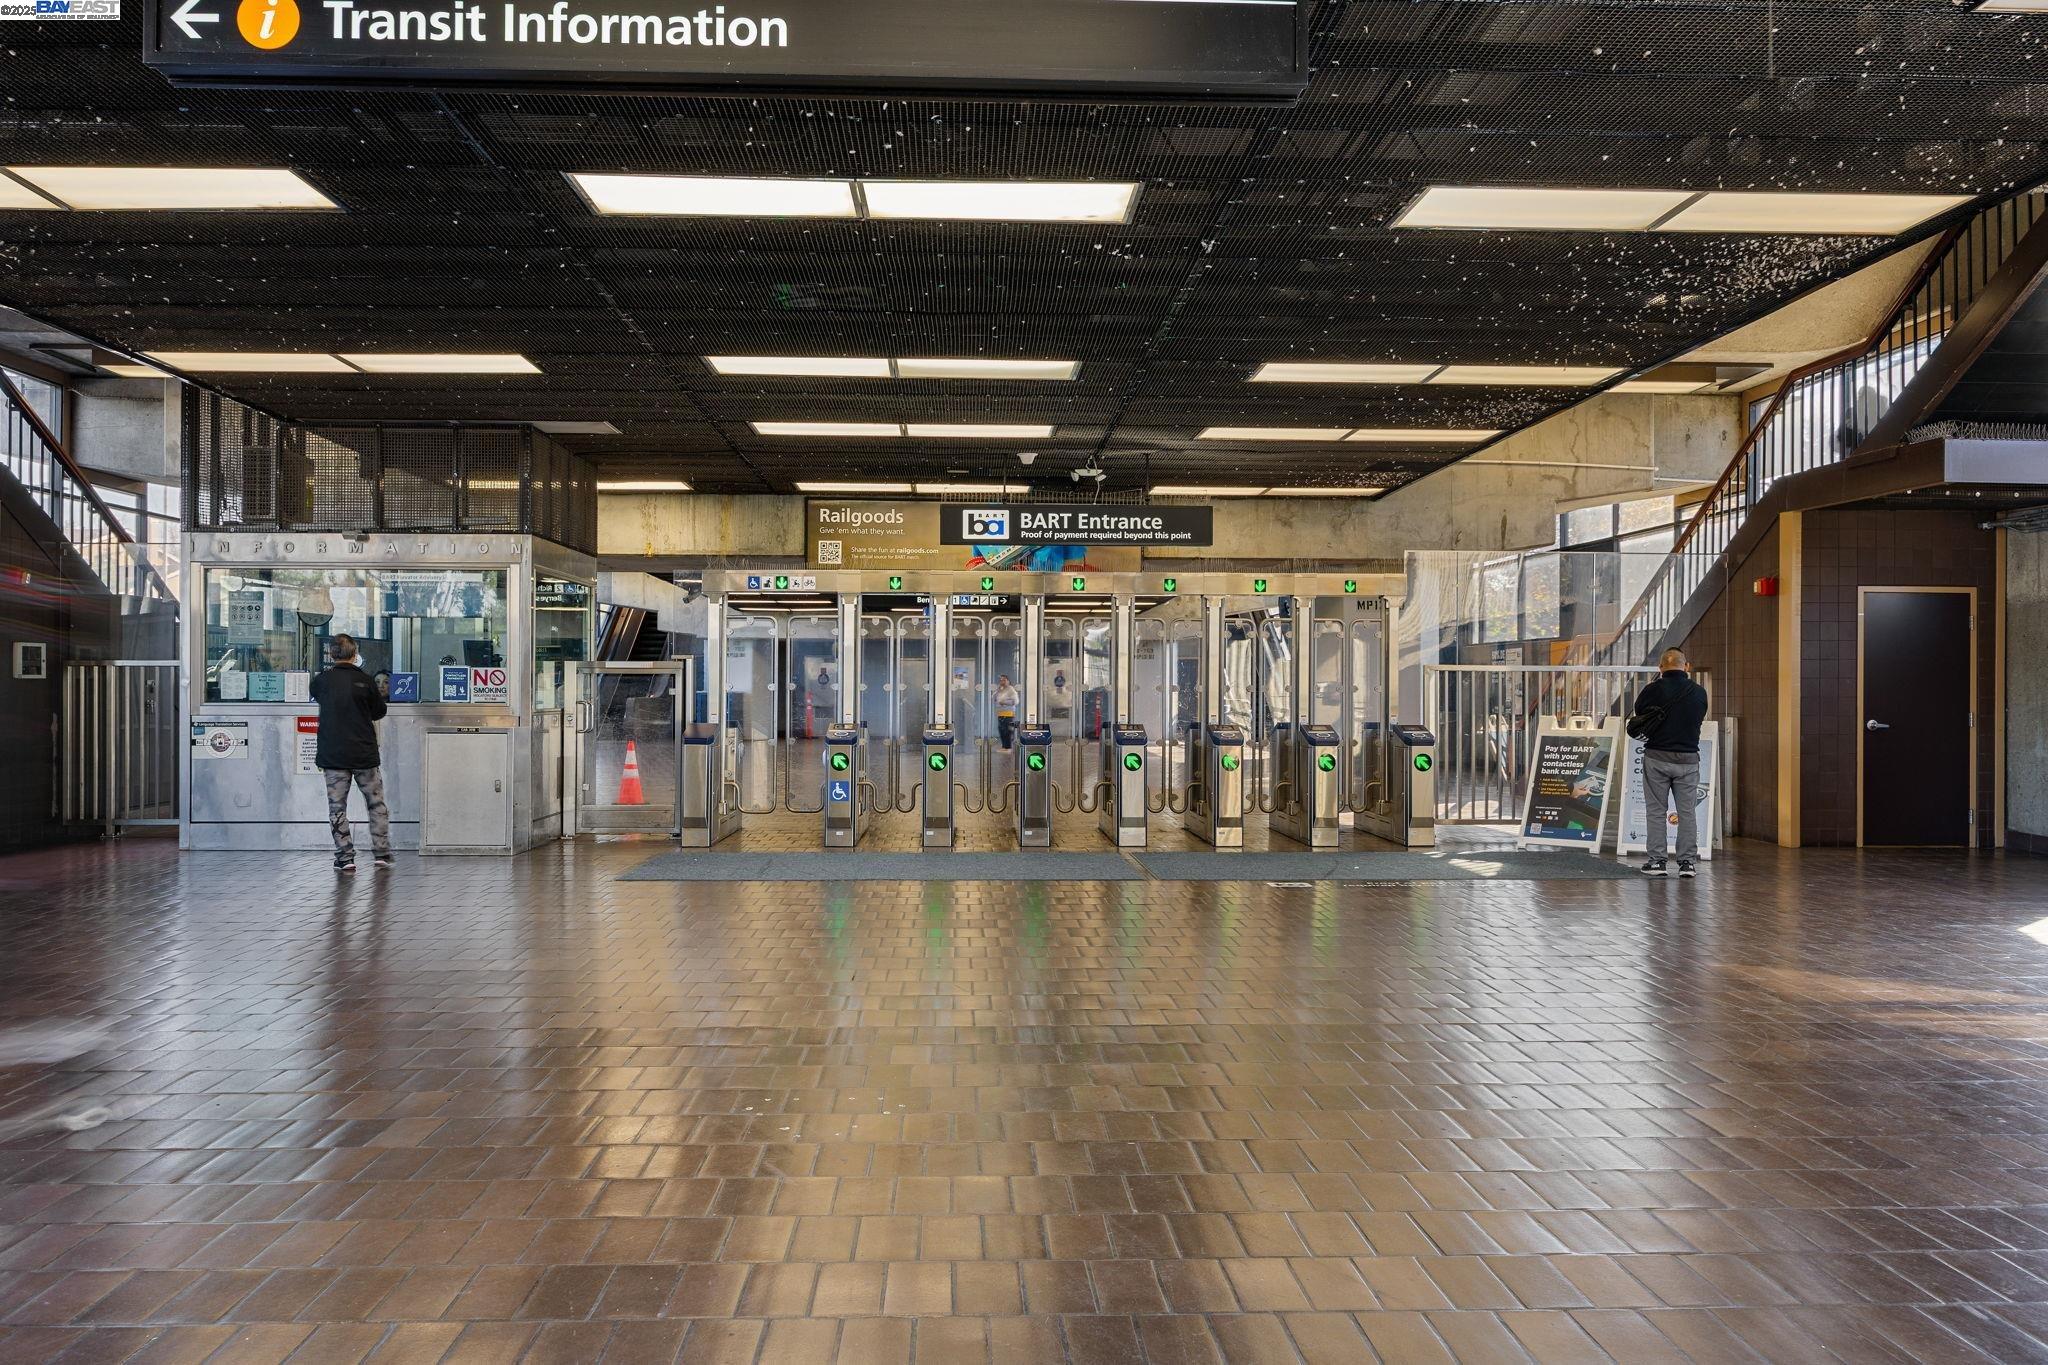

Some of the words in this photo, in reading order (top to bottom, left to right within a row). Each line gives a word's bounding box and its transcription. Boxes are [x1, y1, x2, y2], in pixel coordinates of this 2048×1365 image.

[322, 1, 487, 42] Transit
[504, 2, 788, 47] Information
[819, 508, 904, 526] Railgoods
[1020, 513, 1072, 529] BART
[1078, 513, 1163, 530] Entrance
[850, 527, 869, 535] what
[870, 528, 885, 536] they
[1021, 531, 1043, 539] Proof
[1044, 531, 1053, 539] of
[1054, 532, 1088, 541] payment
[1090, 531, 1122, 541] required
[1124, 532, 1153, 541] beyond
[1170, 532, 1192, 541] point
[896, 547, 939, 555] railgoods.com
[1545, 745, 1559, 753] Pay
[1560, 768, 1581, 776] card!
